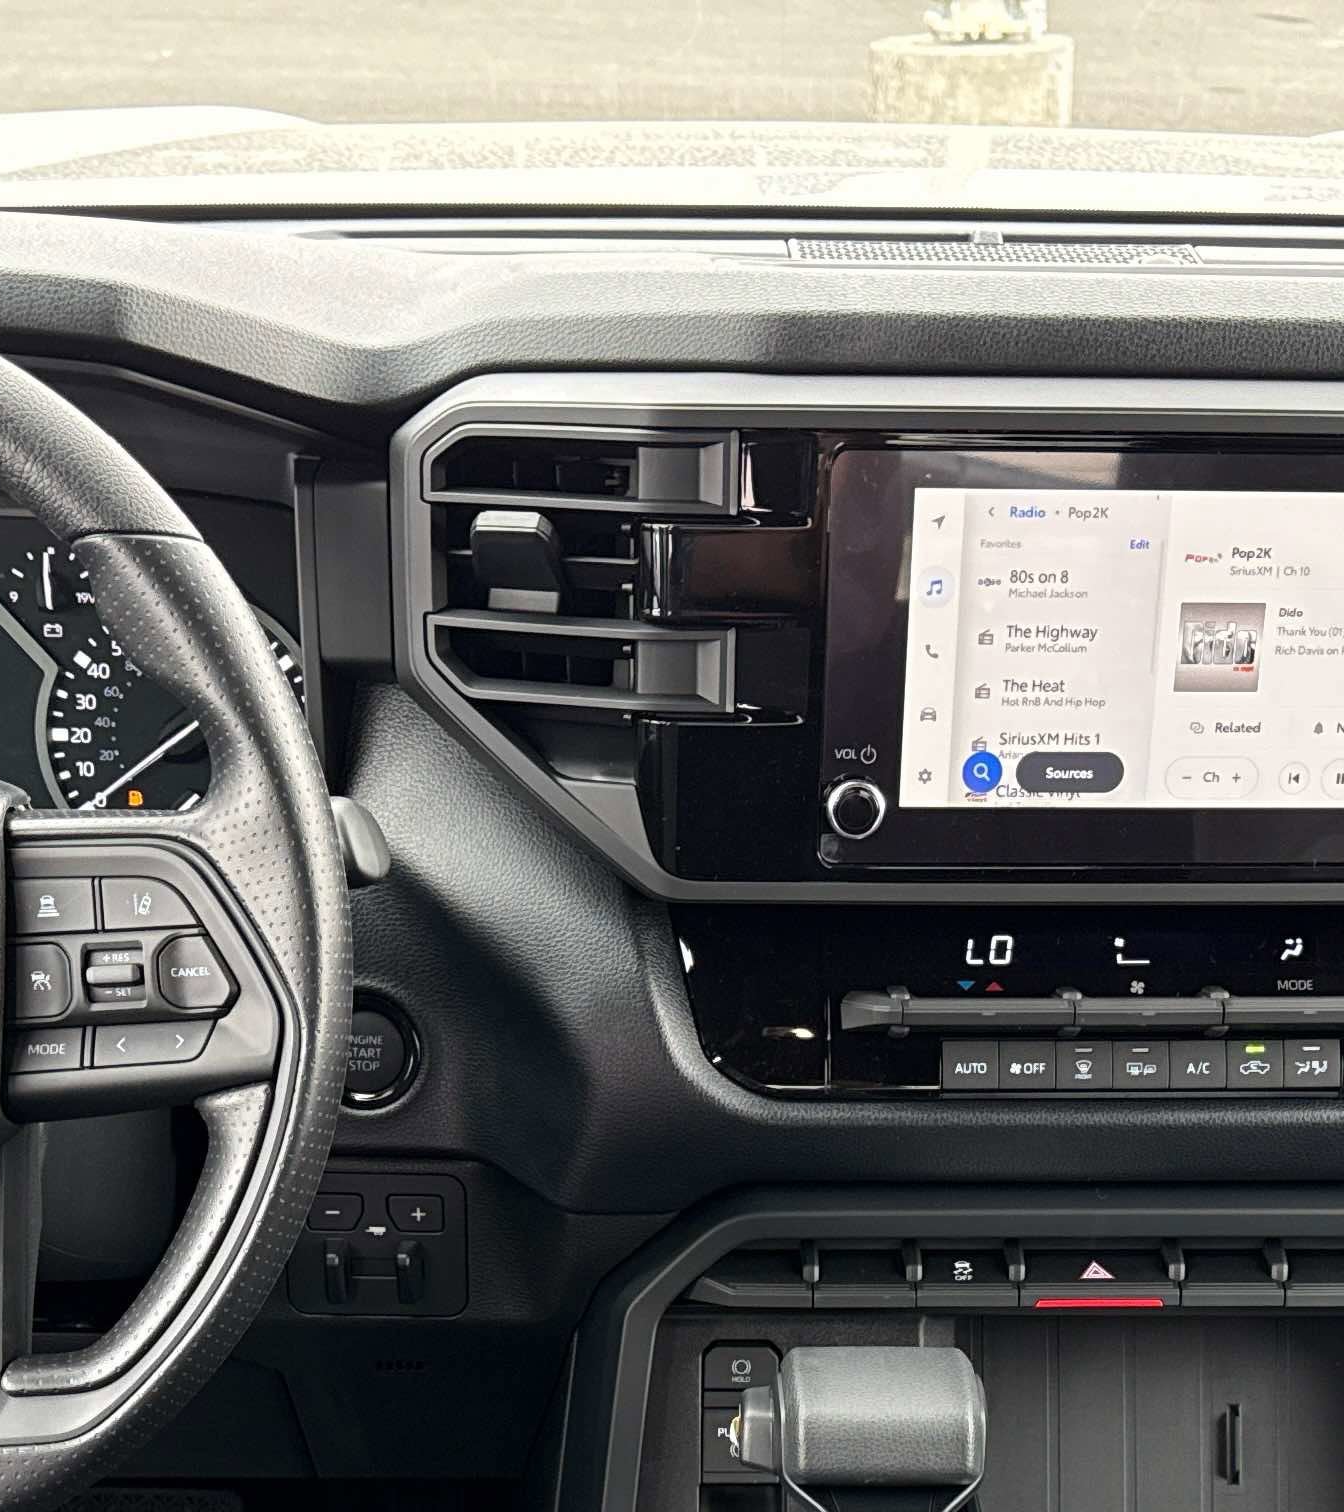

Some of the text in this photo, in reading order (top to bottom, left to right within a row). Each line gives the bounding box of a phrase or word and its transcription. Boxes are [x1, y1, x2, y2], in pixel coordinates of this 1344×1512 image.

[1009, 506, 1109, 522] Radio Pop2K
[980, 539, 1022, 549] Favorites
[1129, 539, 1150, 550] Edit
[1231, 547, 1272, 561] Pop2K
[1009, 570, 1035, 584] 80s
[1038, 573, 1057, 583] on
[1060, 570, 1069, 584] 8
[1229, 567, 1272, 577] SiriusXM
[9, 591, 18, 603] 9
[1008, 588, 1088, 599] Michael Jackson
[1279, 608, 1303, 618] Dido
[1006, 624, 1098, 642] The Highway
[1276, 627, 1306, 637] Thank
[1308, 627, 1327, 637] You
[1005, 643, 1087, 653] Parker McCollum
[1275, 646, 1296, 656] Rich
[1298, 646, 1324, 656] Davis
[87, 663, 110, 679] 40
[1003, 679, 1065, 692] The Heat
[104, 687, 119, 697] 60
[75, 694, 96, 710] 30
[1002, 697, 1020, 707] Hot
[1043, 697, 1063, 707] And
[1065, 697, 1083, 709] Hip
[1085, 697, 1106, 709] Hop
[94, 717, 110, 728] 40
[1215, 722, 1261, 734] Related
[70, 727, 91, 743] 20
[999, 732, 1101, 746] SiriusXM Hits 1
[99, 750, 114, 761] 20
[835, 749, 858, 760] VOL
[75, 761, 94, 777] 10
[1045, 766, 1094, 779] Sources
[1203, 772, 1220, 783] Ch
[95, 793, 107, 808] 0
[965, 935, 1014, 965] LO
[171, 966, 211, 977] CANCEL
[1277, 980, 1314, 990] MODE
[348, 1035, 384, 1045] NGINE
[27, 1043, 66, 1055] MODE
[349, 1060, 380, 1071] STOP
[955, 1063, 987, 1074] AUTO
[1023, 1063, 1046, 1074] OFF
[1186, 1062, 1211, 1074] A/C
